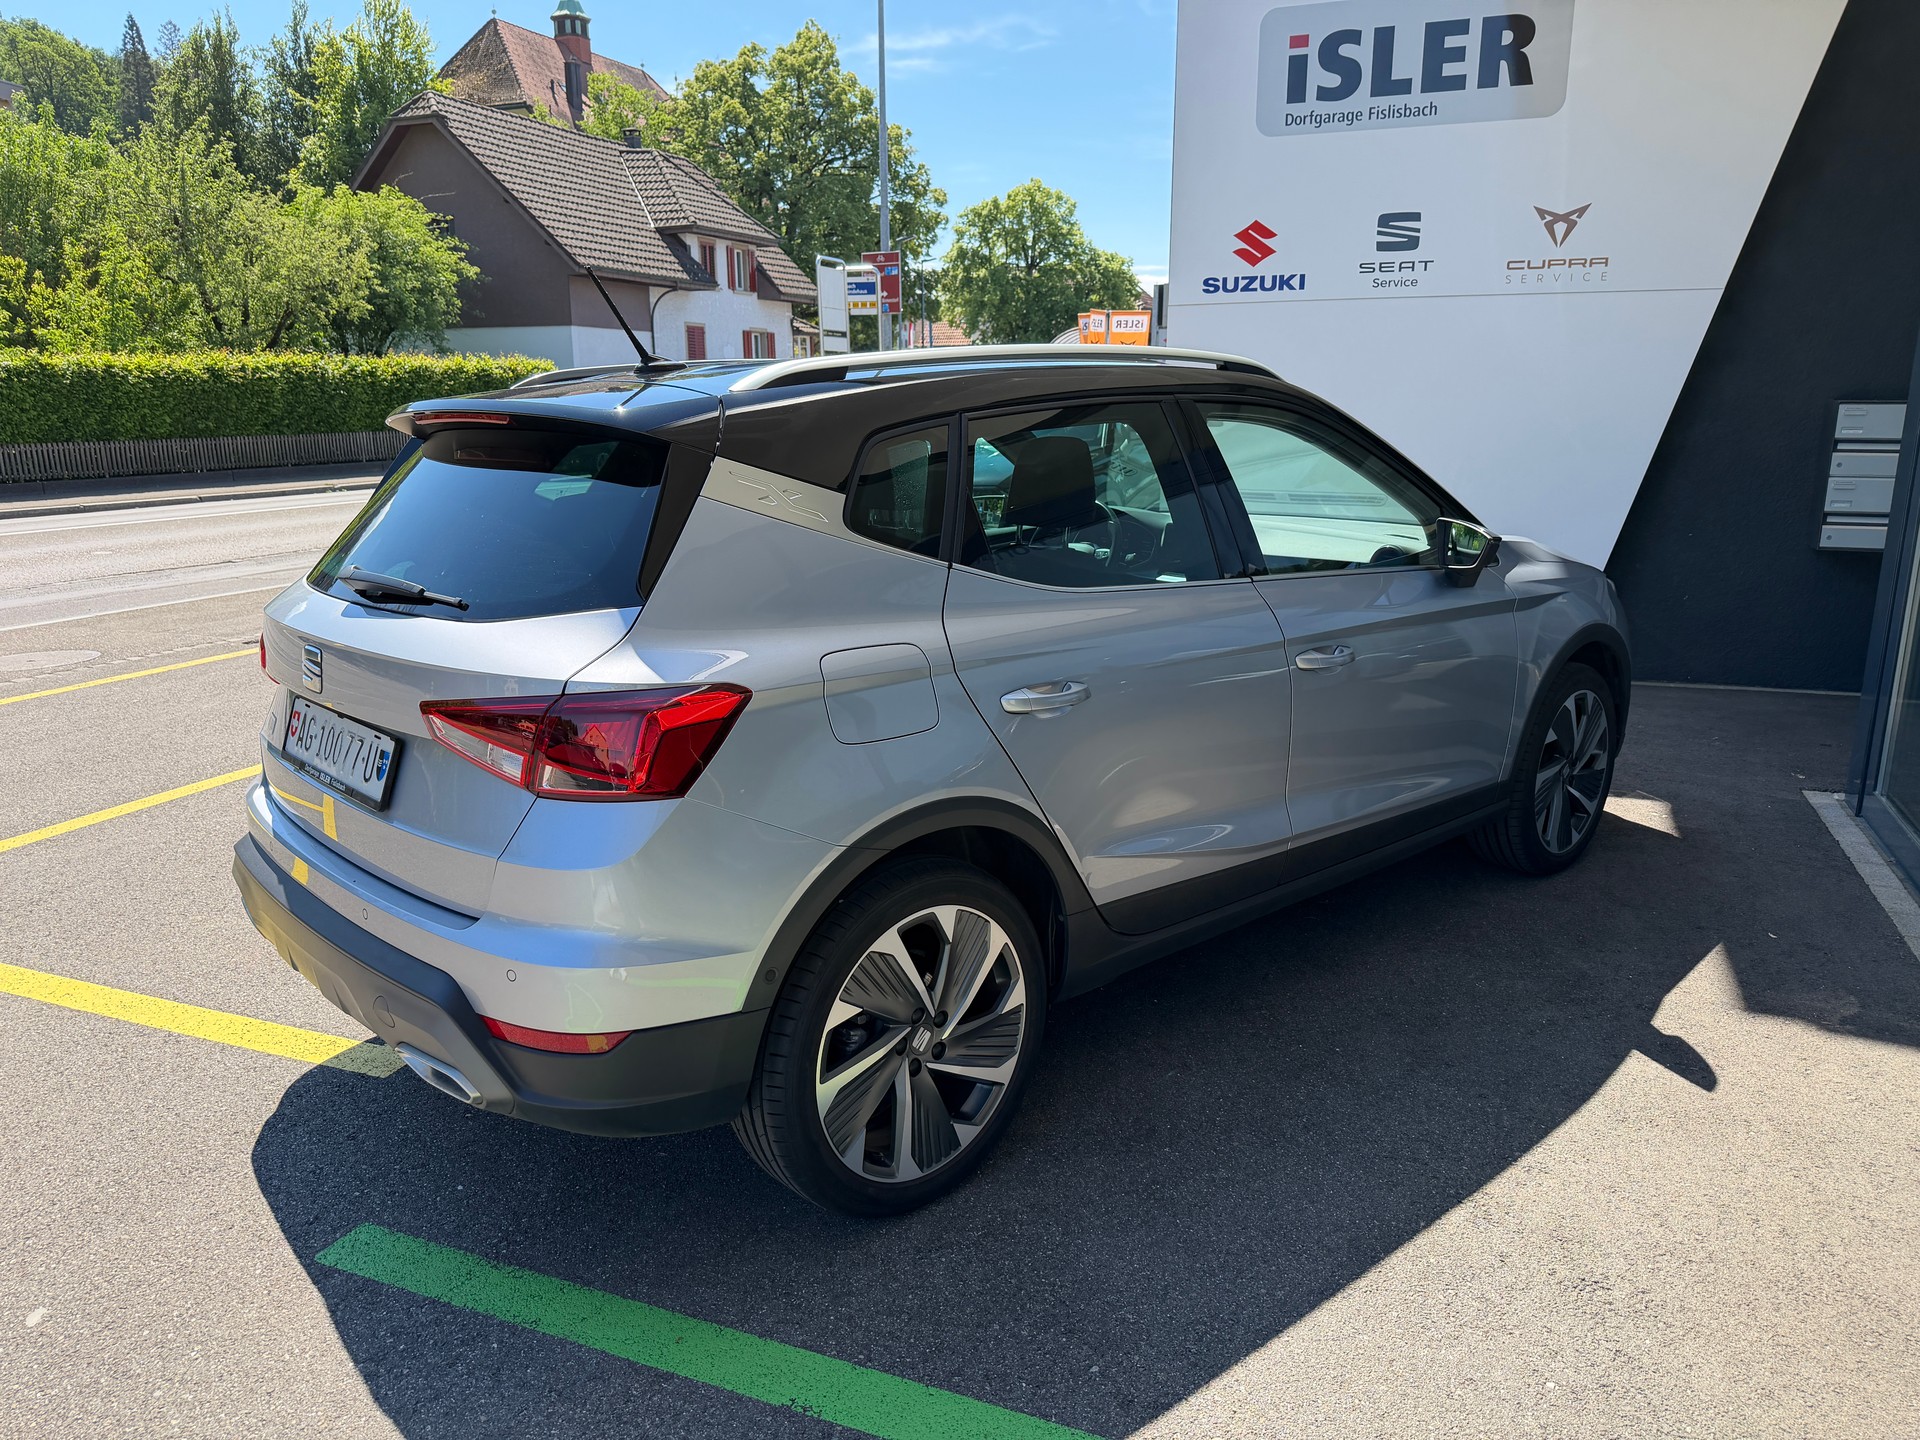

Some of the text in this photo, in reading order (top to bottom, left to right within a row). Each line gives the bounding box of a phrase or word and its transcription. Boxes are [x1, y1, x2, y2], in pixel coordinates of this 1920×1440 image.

[1285, 101, 1438, 128] Dorfgarage Fislisbach
[1359, 260, 1434, 274] SEAT
[1506, 256, 1610, 271] CUPRA
[1202, 273, 1306, 294] SUZUKI
[1372, 276, 1419, 289] Service
[1505, 271, 1608, 285] SERVICE
